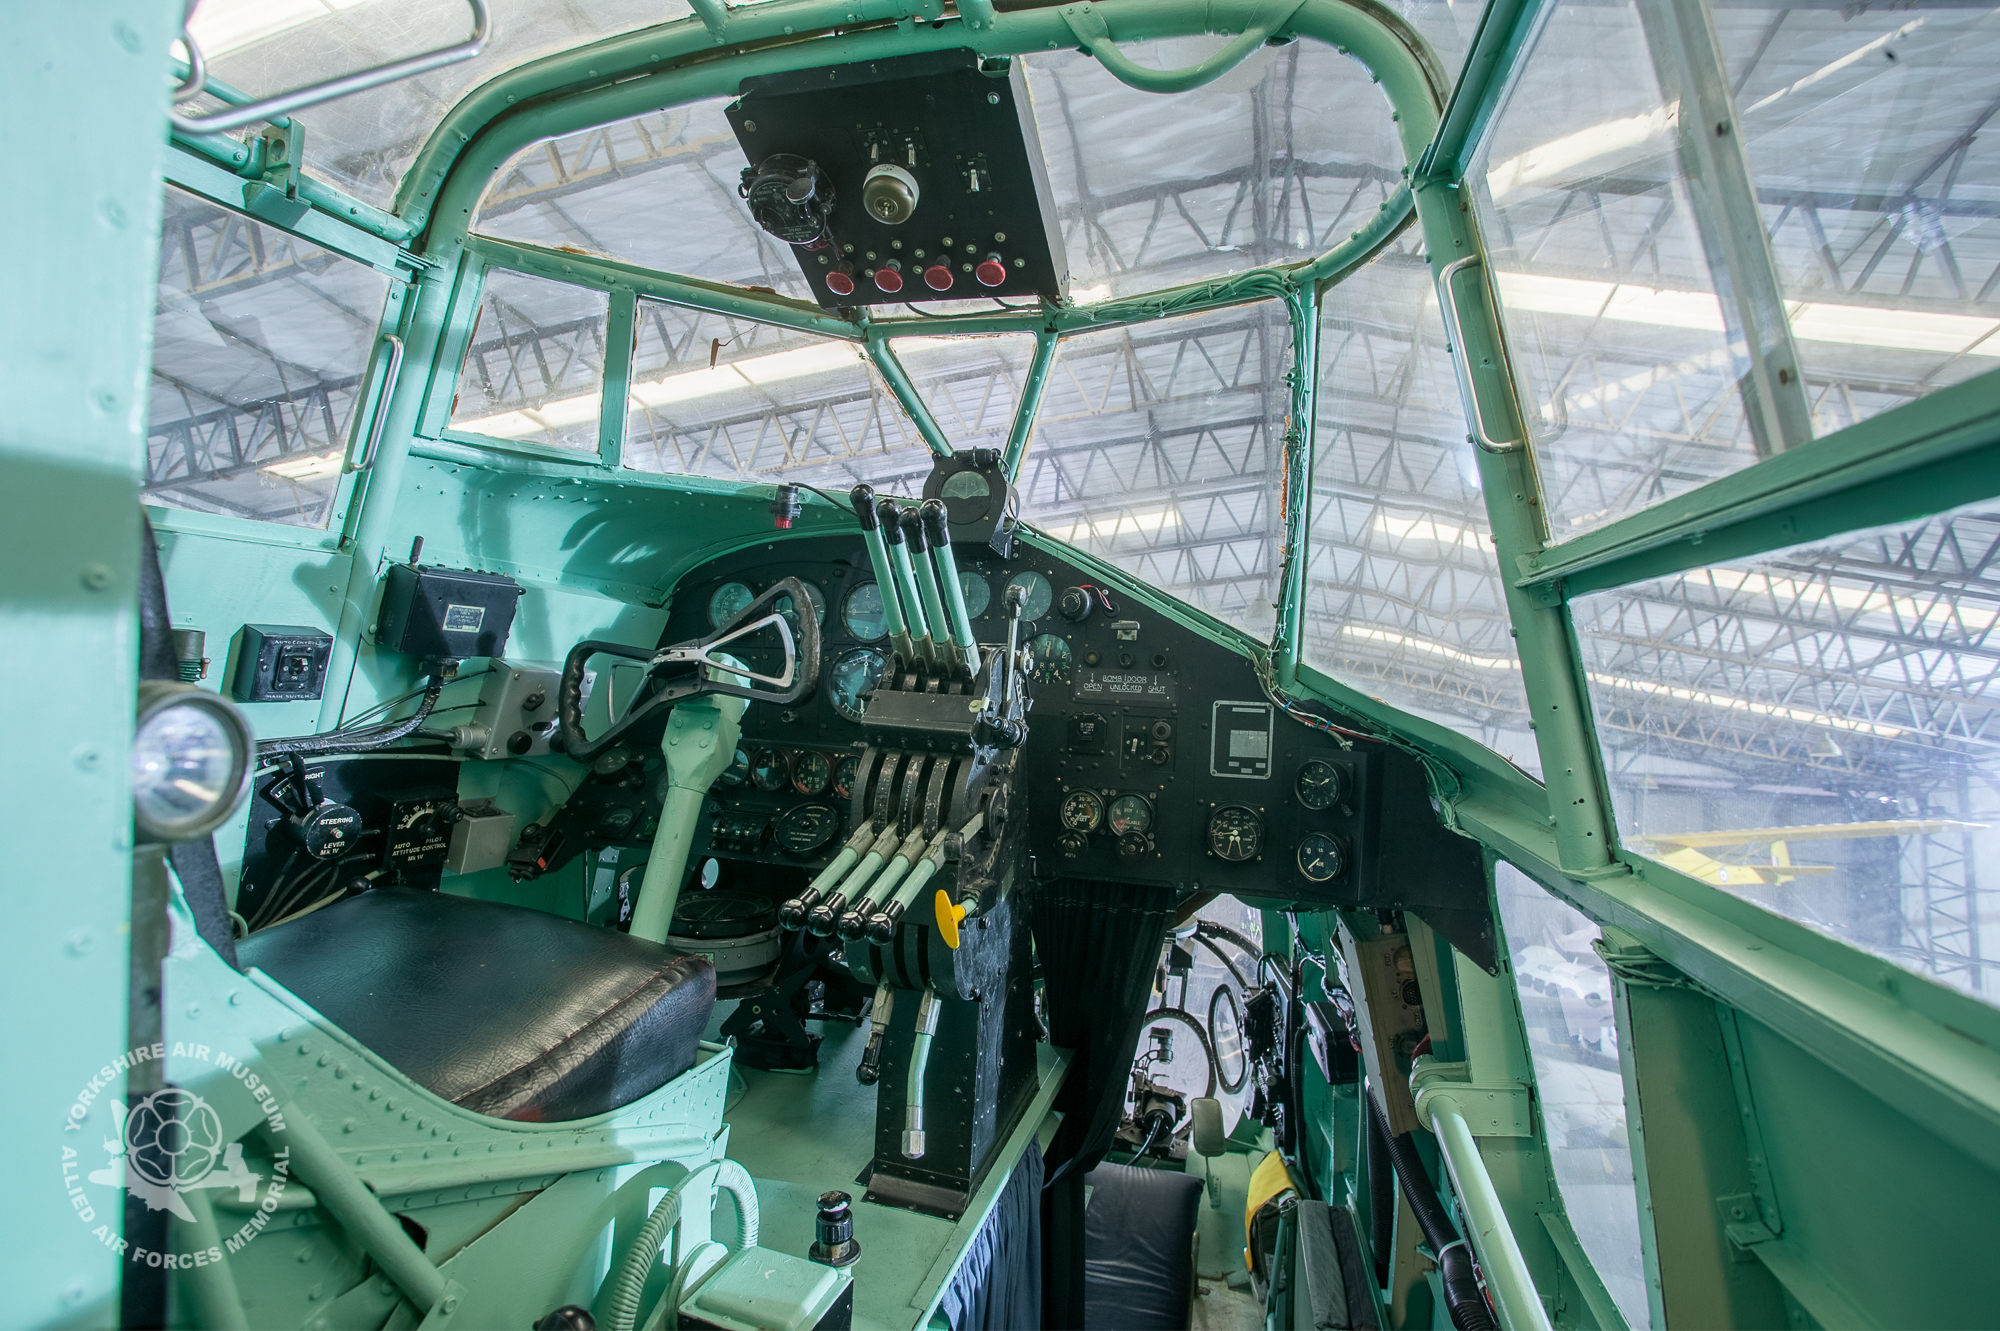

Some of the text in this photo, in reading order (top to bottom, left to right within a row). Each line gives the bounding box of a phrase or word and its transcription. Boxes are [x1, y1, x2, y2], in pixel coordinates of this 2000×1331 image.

[865, 590, 871, 598] 2
[864, 626, 870, 634] 2
[1036, 642, 1042, 651] 9
[1061, 651, 1066, 659] 2
[1061, 661, 1066, 670] 3
[1035, 669, 1041, 677] 6
[1045, 672, 1051, 680] 5
[1053, 669, 1059, 677] 4
[1102, 674, 1147, 683] BOMB DOOR
[1083, 682, 1166, 693] OPEN UNLOCKED SHUT
[304, 771, 325, 780] RIGHT
[274, 783, 292, 799] LEFT
[319, 816, 353, 826] STEERING
[323, 841, 345, 849] LEVER
[393, 836, 442, 850] AUTO PILOT
[391, 842, 447, 857] ATTITUDE CONTROL
